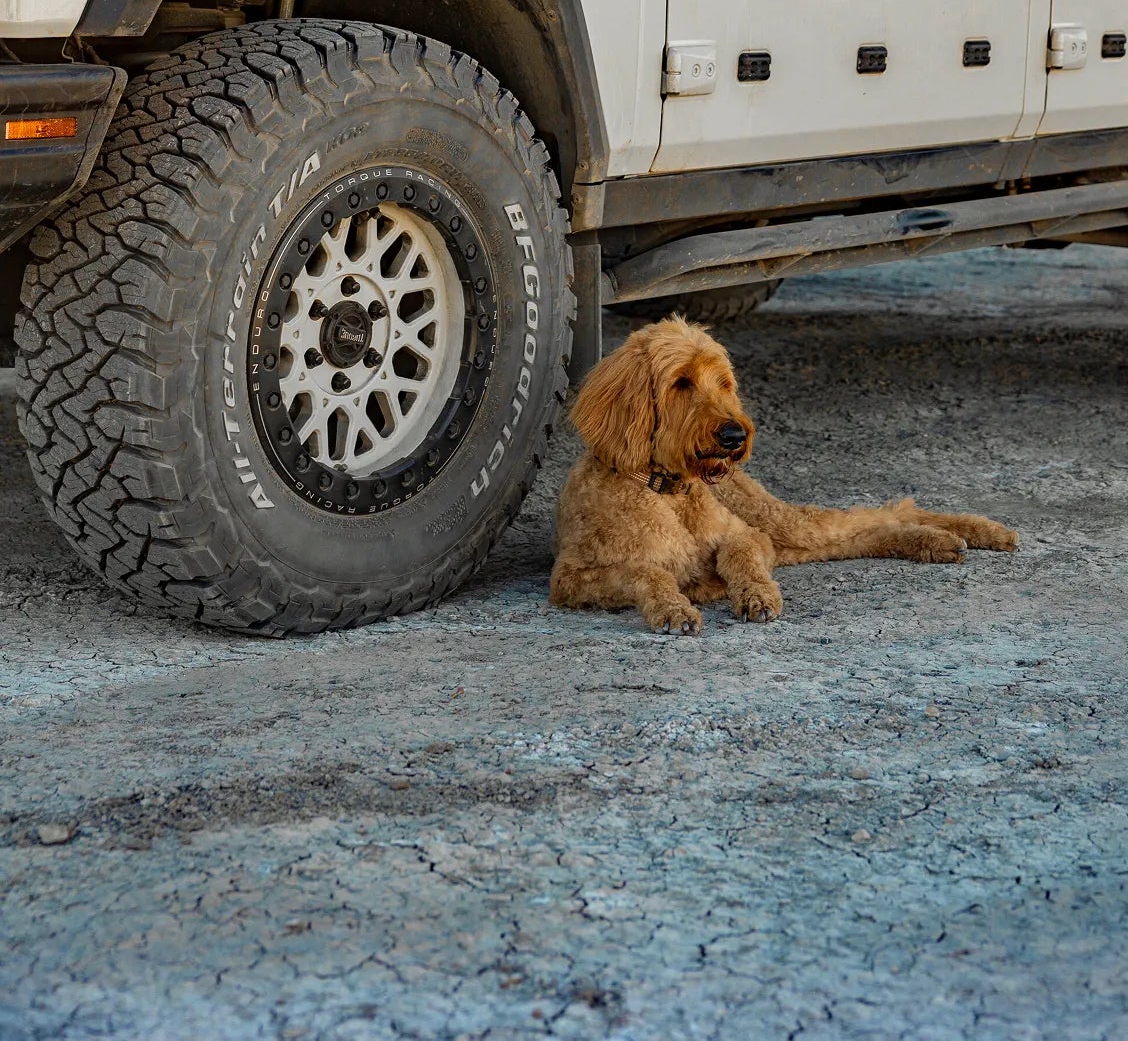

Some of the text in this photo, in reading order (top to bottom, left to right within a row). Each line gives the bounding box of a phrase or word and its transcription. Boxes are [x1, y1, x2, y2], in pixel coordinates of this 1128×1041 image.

[323, 168, 393, 200] TORQUE
[405, 169, 462, 208] RACING
[222, 223, 276, 509] All-Terrain
[267, 150, 322, 220] T/A
[251, 290, 271, 391] ENDURO
[470, 203, 543, 498] BFGoodrich
[295, 481, 356, 514] RACING
